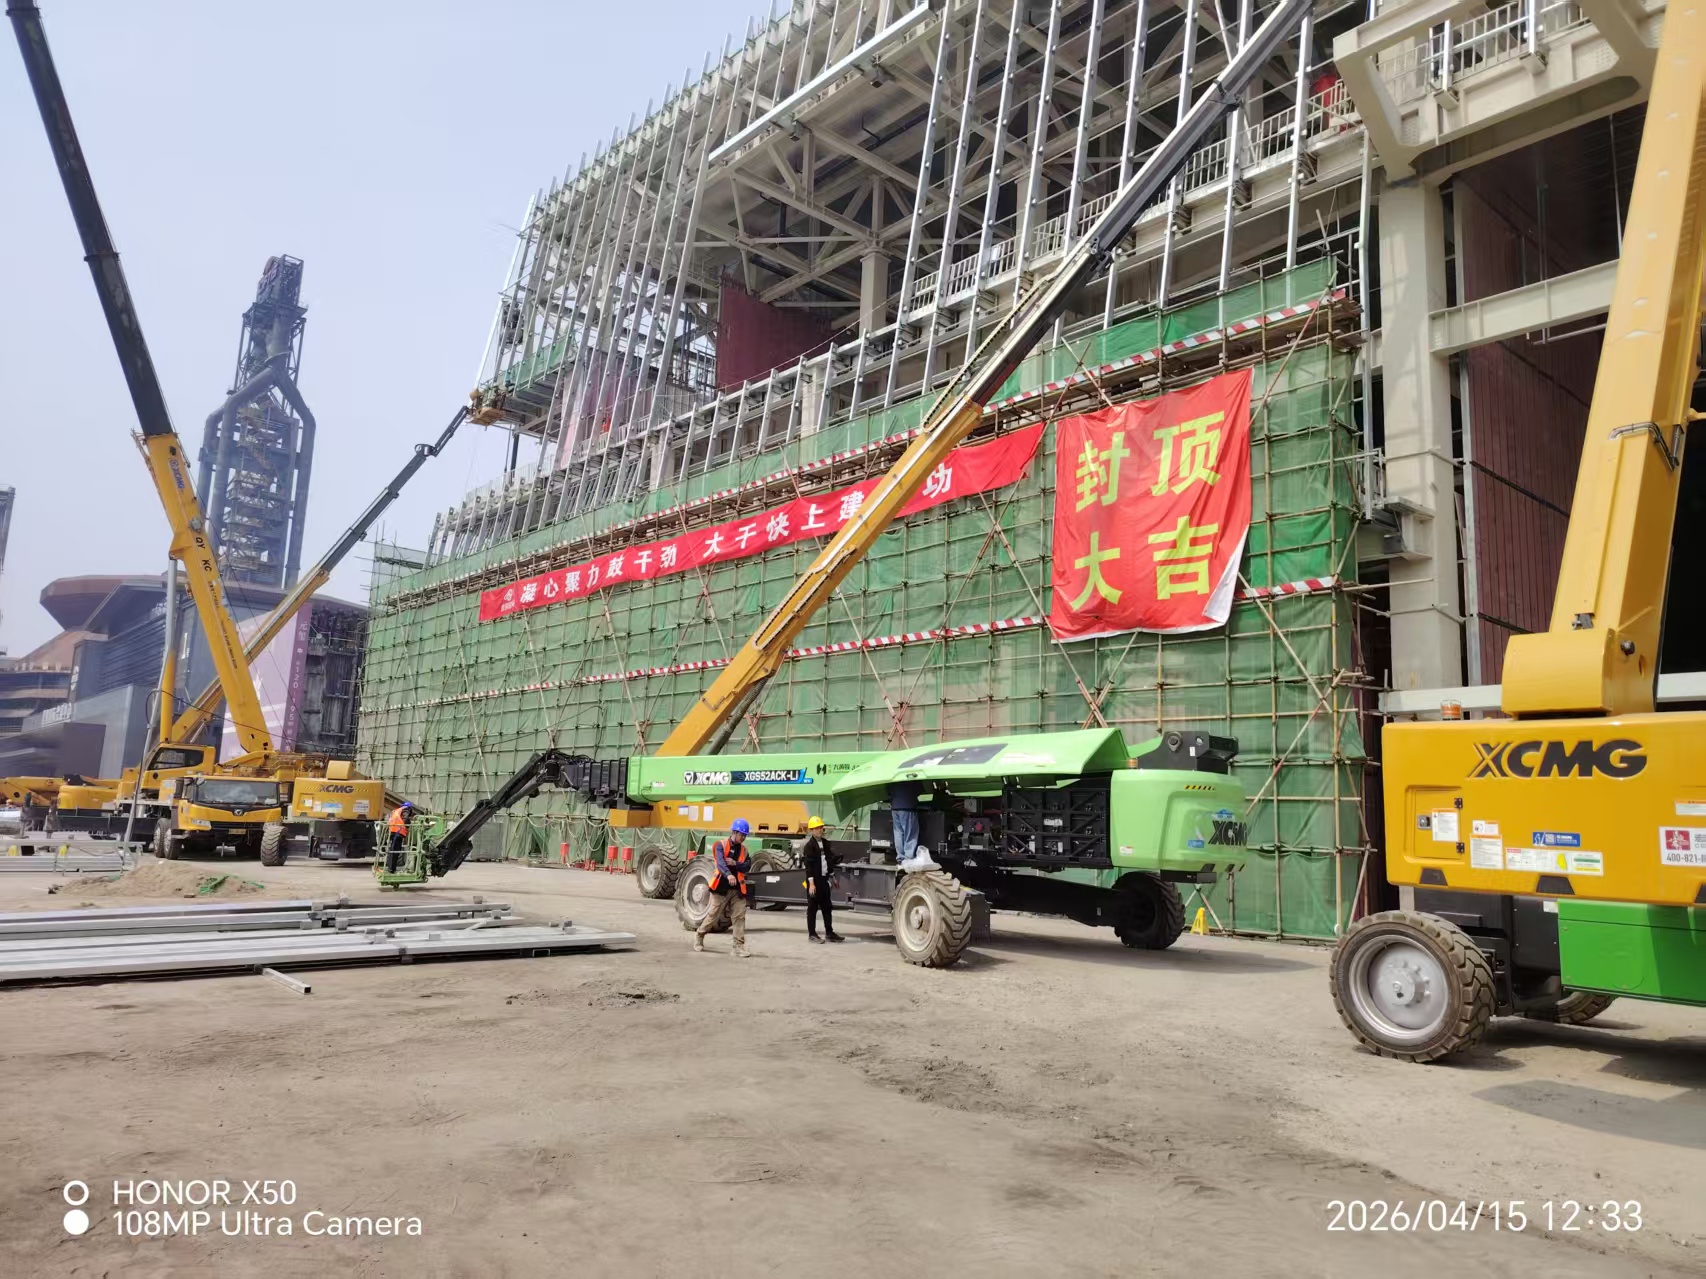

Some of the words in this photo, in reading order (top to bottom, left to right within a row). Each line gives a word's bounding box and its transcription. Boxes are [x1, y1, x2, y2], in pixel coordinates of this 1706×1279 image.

[1075, 410, 1225, 513] 封顶
[519, 543, 678, 604] 凝心聚力鼓干劲
[702, 461, 953, 559] 大干快上建功
[1069, 515, 1219, 612] 大吉
[319, 784, 354, 794] XCMG
[694, 771, 731, 785] XCMG
[1466, 739, 1648, 780] XCMG
